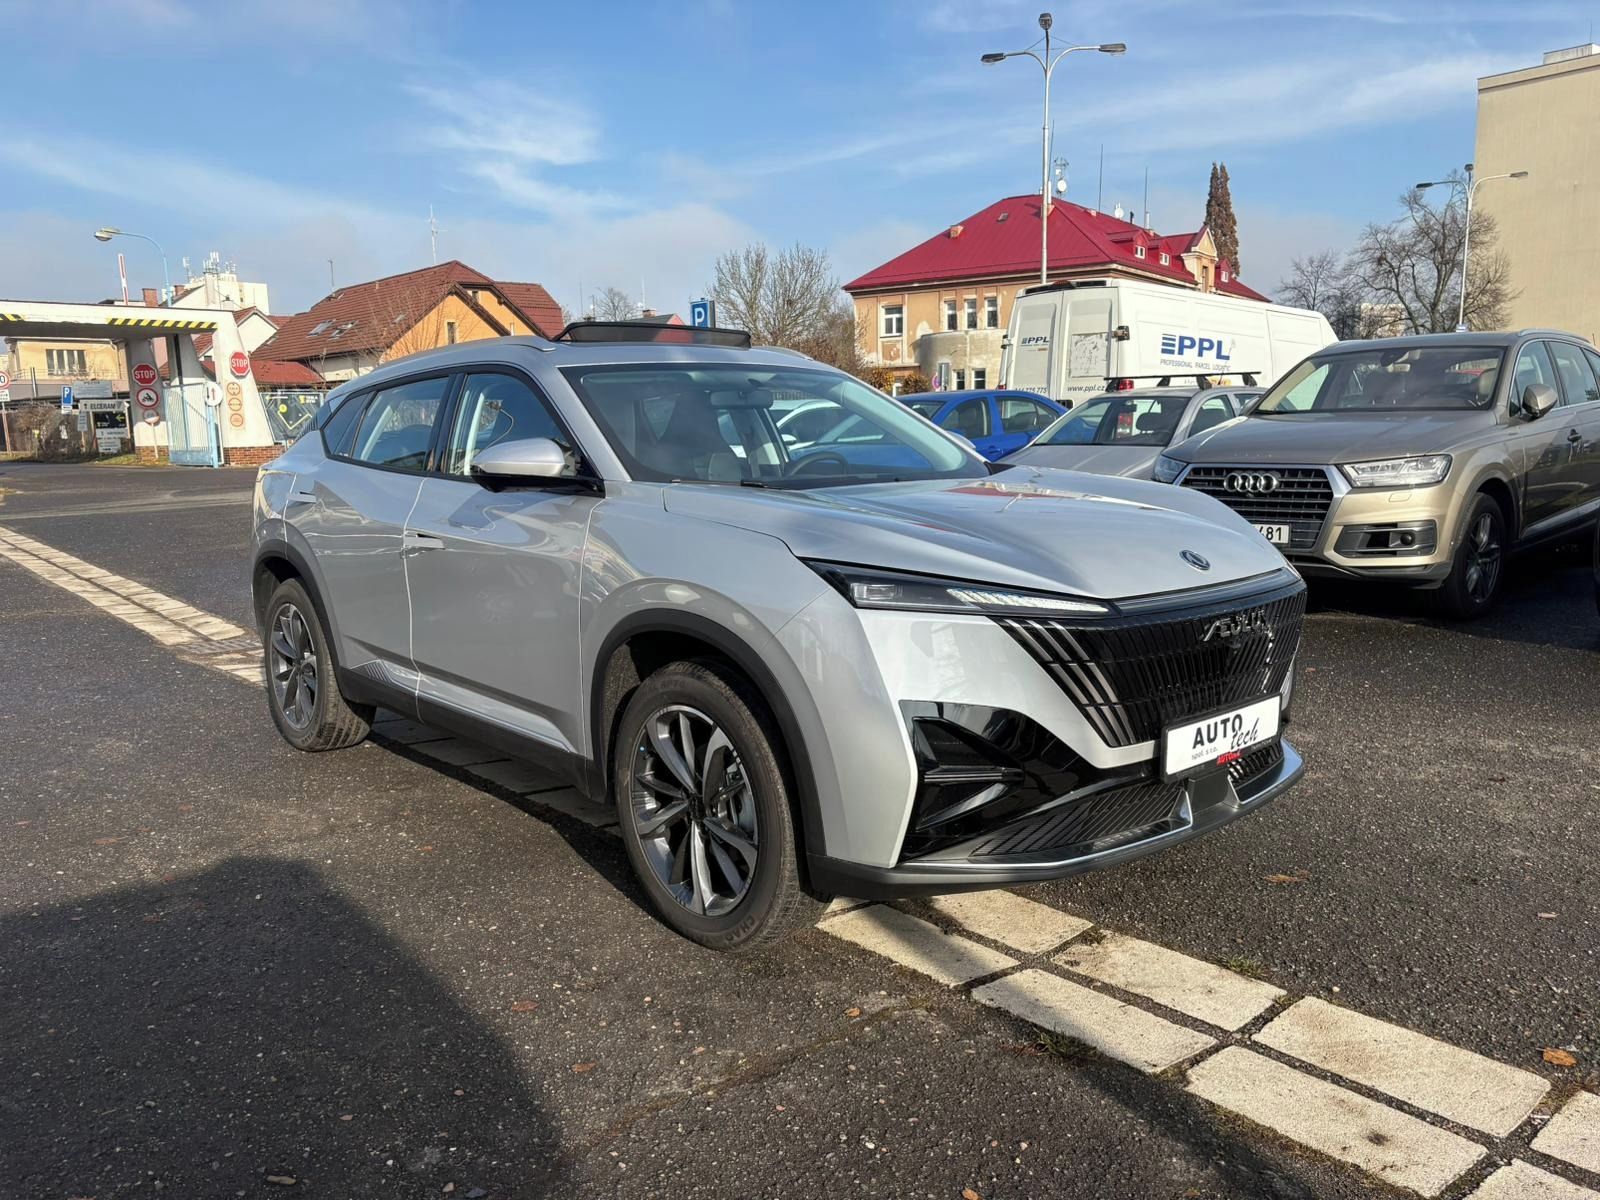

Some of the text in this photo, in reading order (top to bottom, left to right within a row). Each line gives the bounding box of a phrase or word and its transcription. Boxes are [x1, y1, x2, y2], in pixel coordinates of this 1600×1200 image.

[694, 307, 705, 327] P
[232, 358, 248, 368] STOP
[135, 370, 155, 379] STOP
[64, 387, 70, 398] P
[1067, 384, 1105, 393] www.ppl.cz
[1192, 713, 1243, 749] AUTO
[1230, 717, 1260, 750] tech
